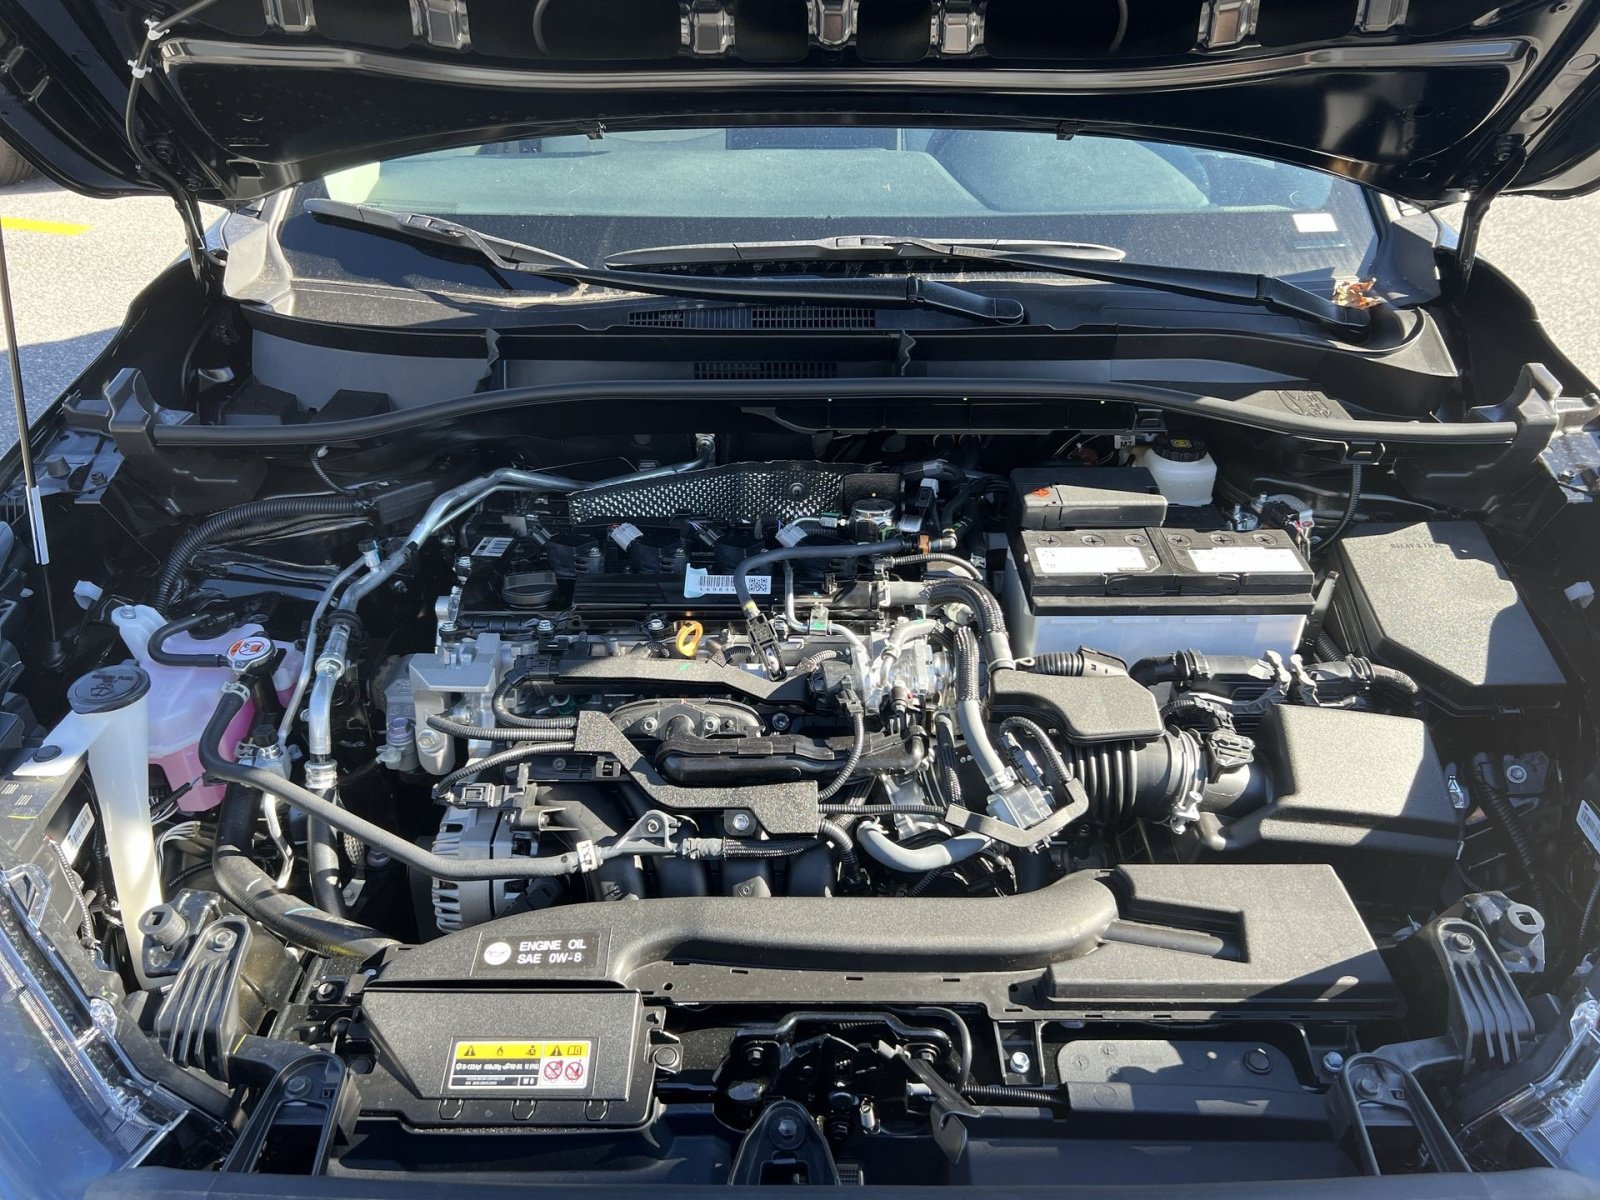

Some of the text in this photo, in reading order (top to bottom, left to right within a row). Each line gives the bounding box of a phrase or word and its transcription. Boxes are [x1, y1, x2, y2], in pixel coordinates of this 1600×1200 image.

[519, 939, 588, 952] ENGINE OIL
[516, 953, 543, 964] SAE
[549, 952, 582, 964] 0W-8
